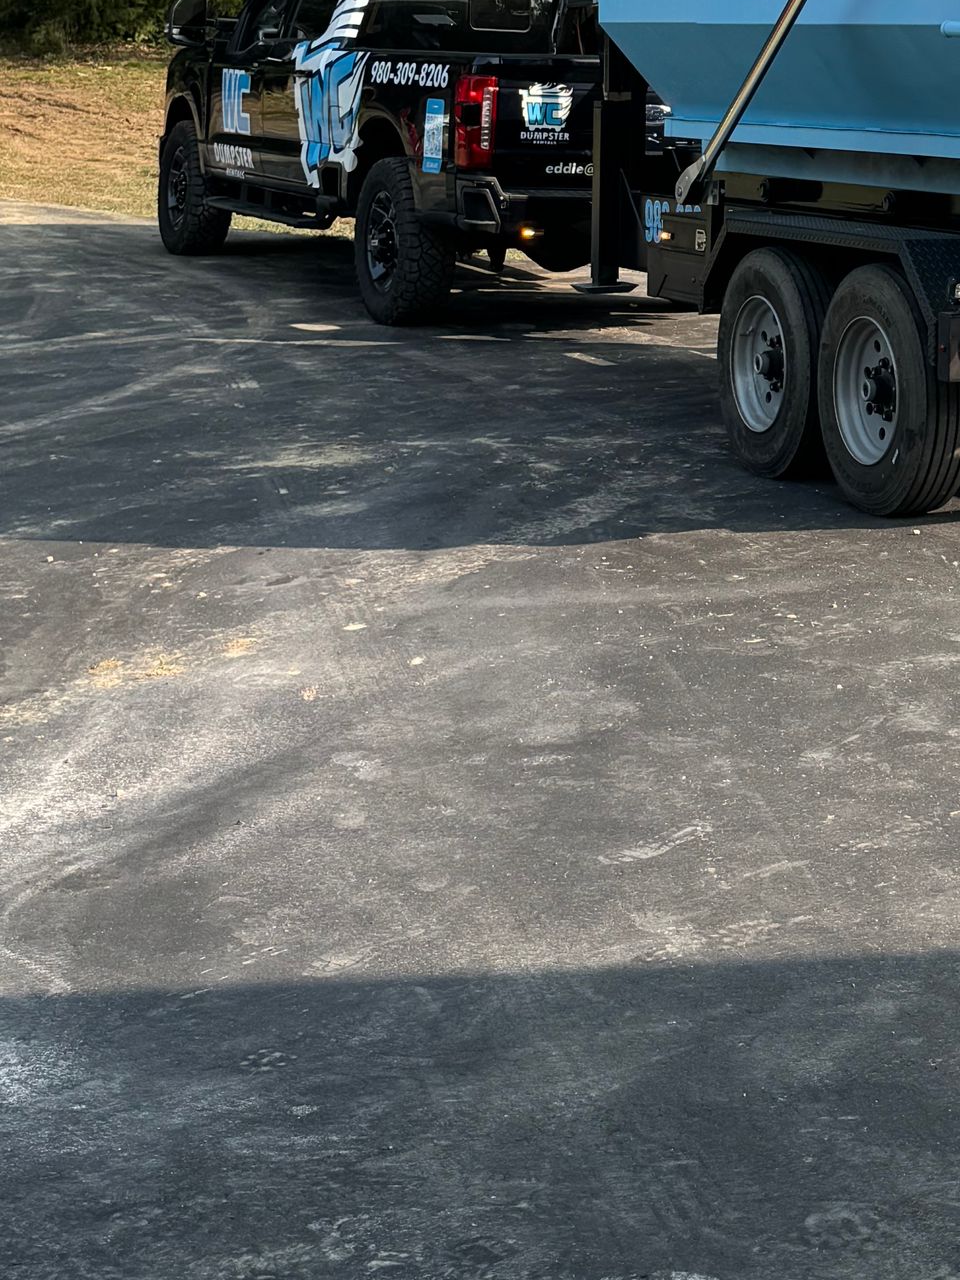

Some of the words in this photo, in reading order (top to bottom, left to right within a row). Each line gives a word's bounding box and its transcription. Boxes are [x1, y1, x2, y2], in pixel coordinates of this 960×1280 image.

[370, 61, 450, 89] 980-309-8206
[222, 68, 251, 135] WC
[527, 101, 564, 127] WC
[520, 131, 570, 141] DUMPSTER
[213, 142, 255, 169] DUMPSTER
